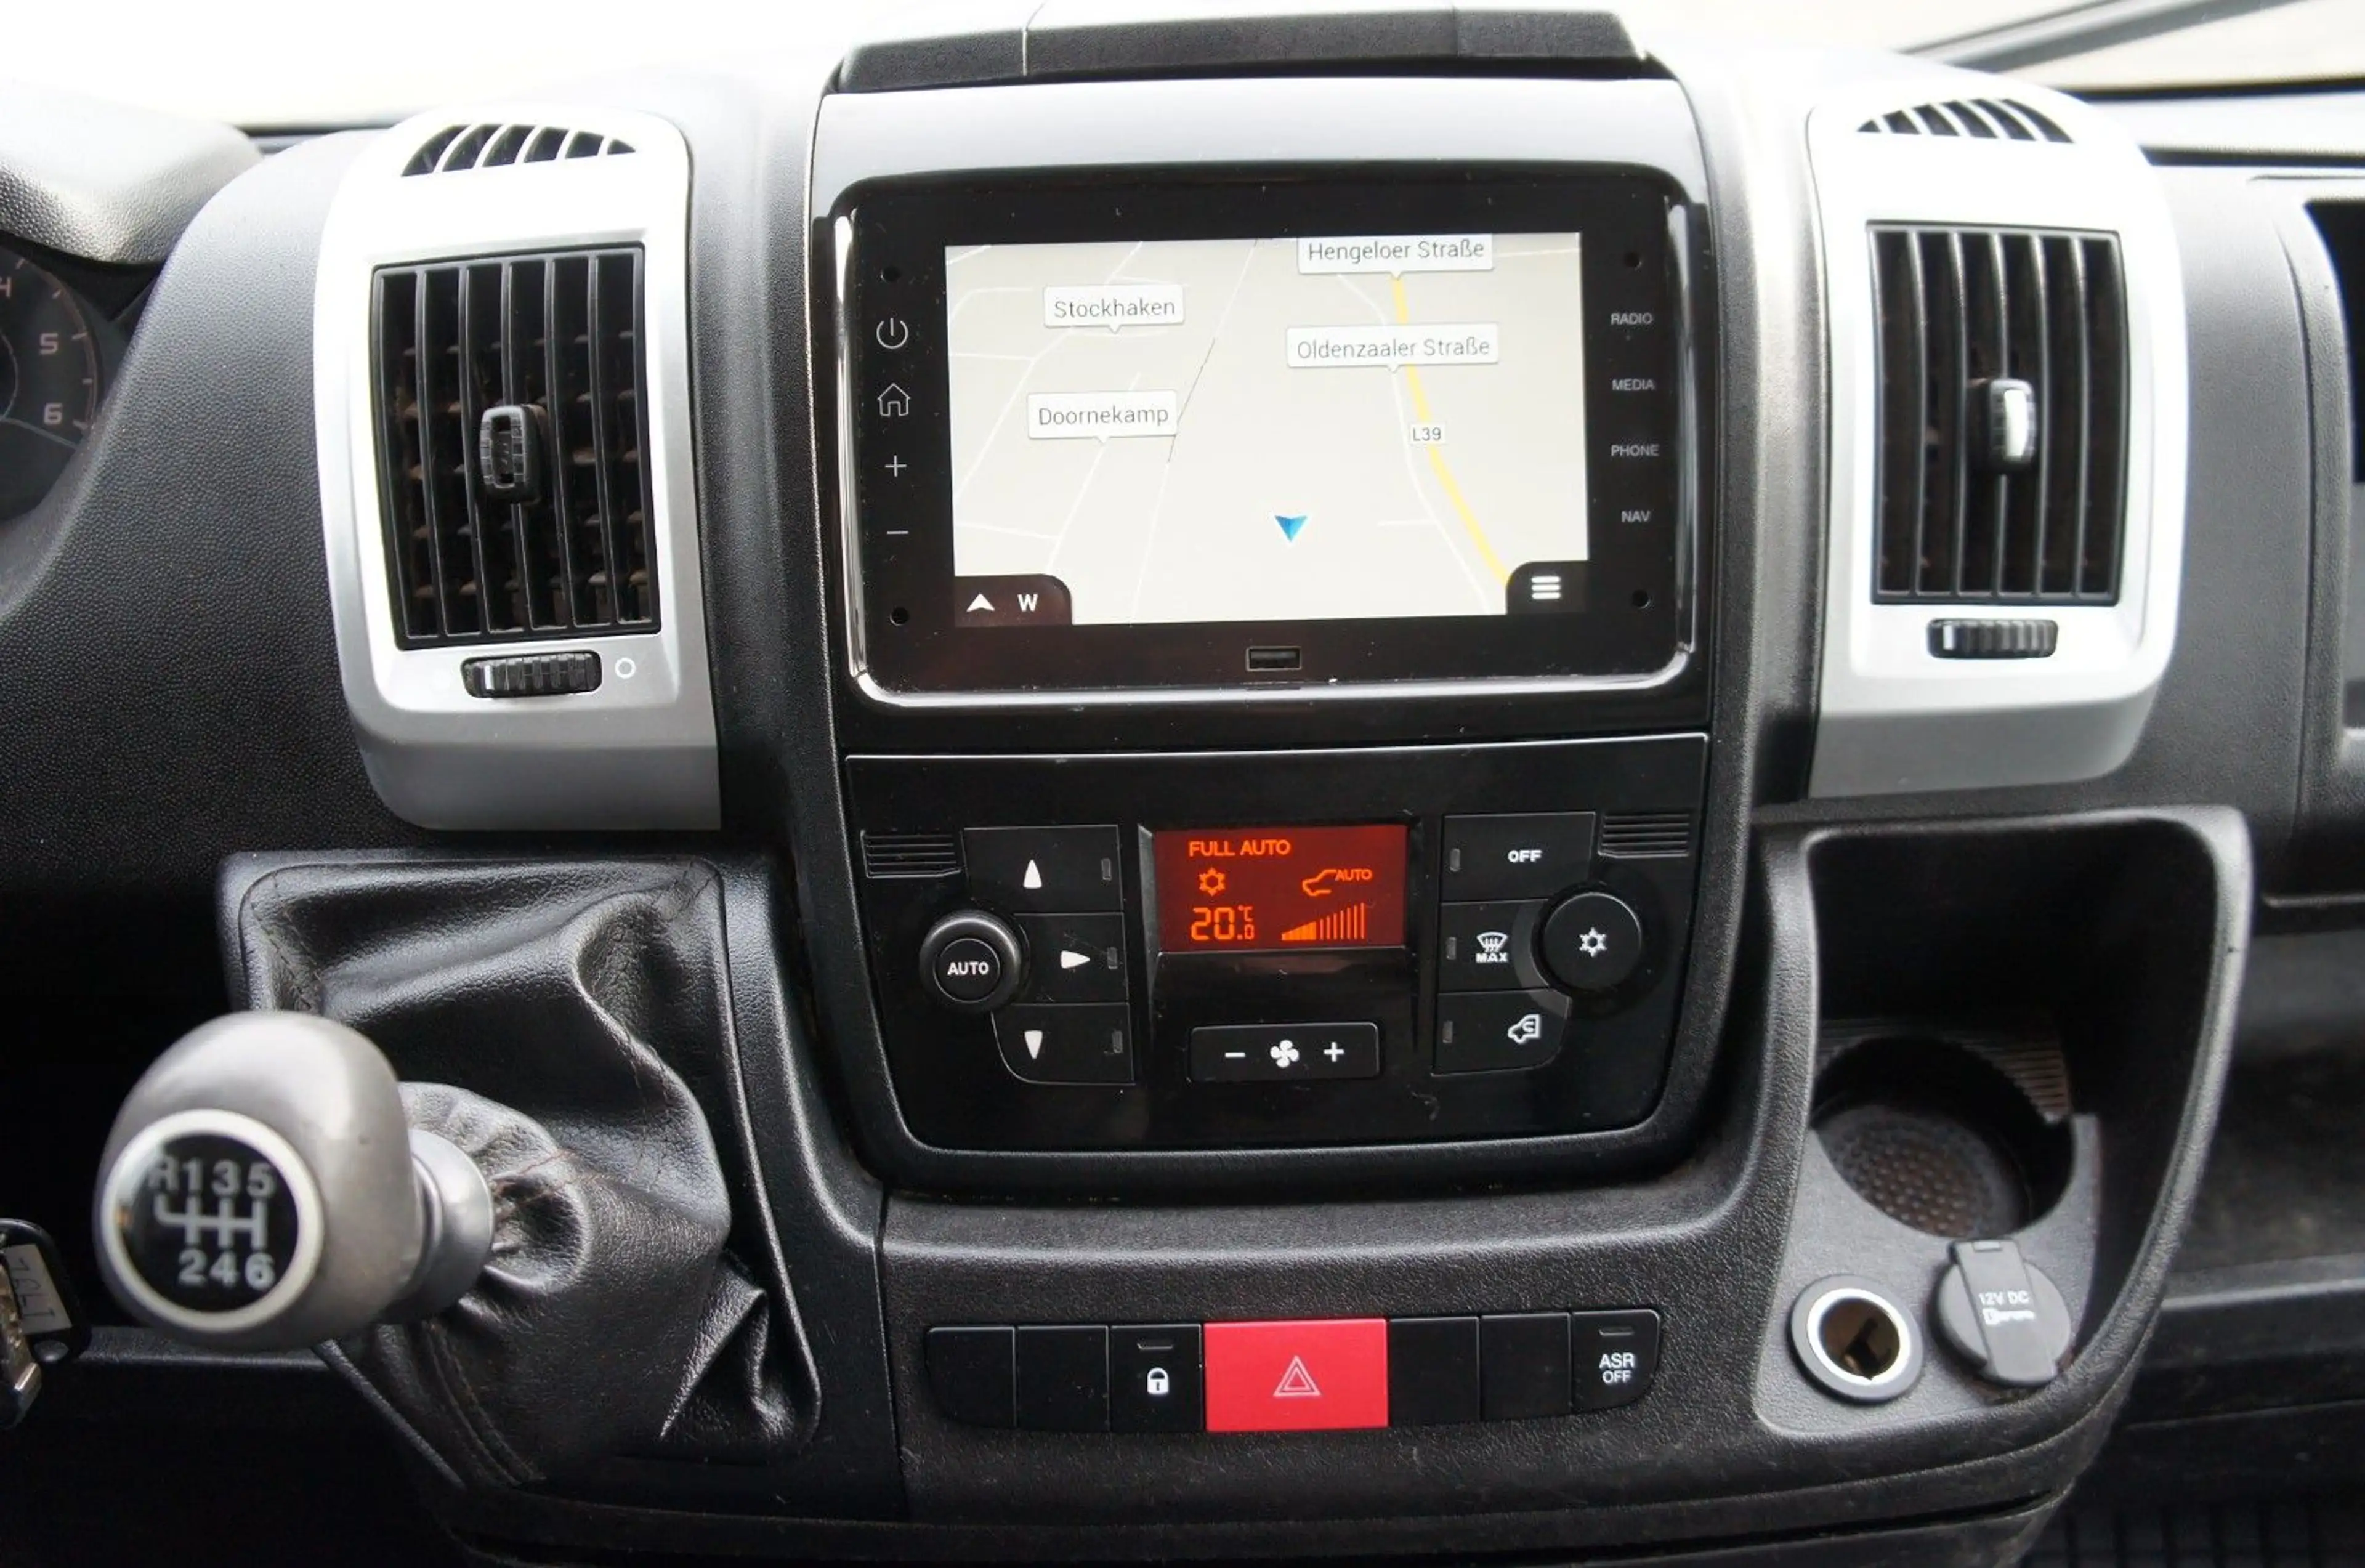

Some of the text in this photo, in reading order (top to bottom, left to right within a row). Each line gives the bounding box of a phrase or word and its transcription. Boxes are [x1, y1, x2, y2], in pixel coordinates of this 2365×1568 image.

[1308, 240, 1484, 264] Hengeloer Straße
[1054, 297, 1175, 318] Stockhaken
[1611, 312, 1654, 325] RADIO
[39, 333, 59, 355] 5
[1297, 337, 1490, 360] Oldenzaaler Straße
[1612, 379, 1655, 391] MEDIA
[43, 403, 63, 425] 6
[1039, 403, 1169, 426] Doornekamp
[1412, 427, 1442, 442] L39
[1611, 444, 1659, 456] PHONE
[1621, 511, 1651, 523] NAV
[1017, 594, 1038, 612] W
[1189, 839, 1291, 857] FULL AUTO
[1508, 849, 1542, 862] OFF
[1335, 868, 1373, 881] AUTO
[1476, 952, 1508, 963] MAX
[947, 961, 989, 976] AUTO
[2008, 1290, 2030, 1304] DC
[1599, 1352, 1635, 1369] ASR
[1602, 1370, 1631, 1384] OFF
